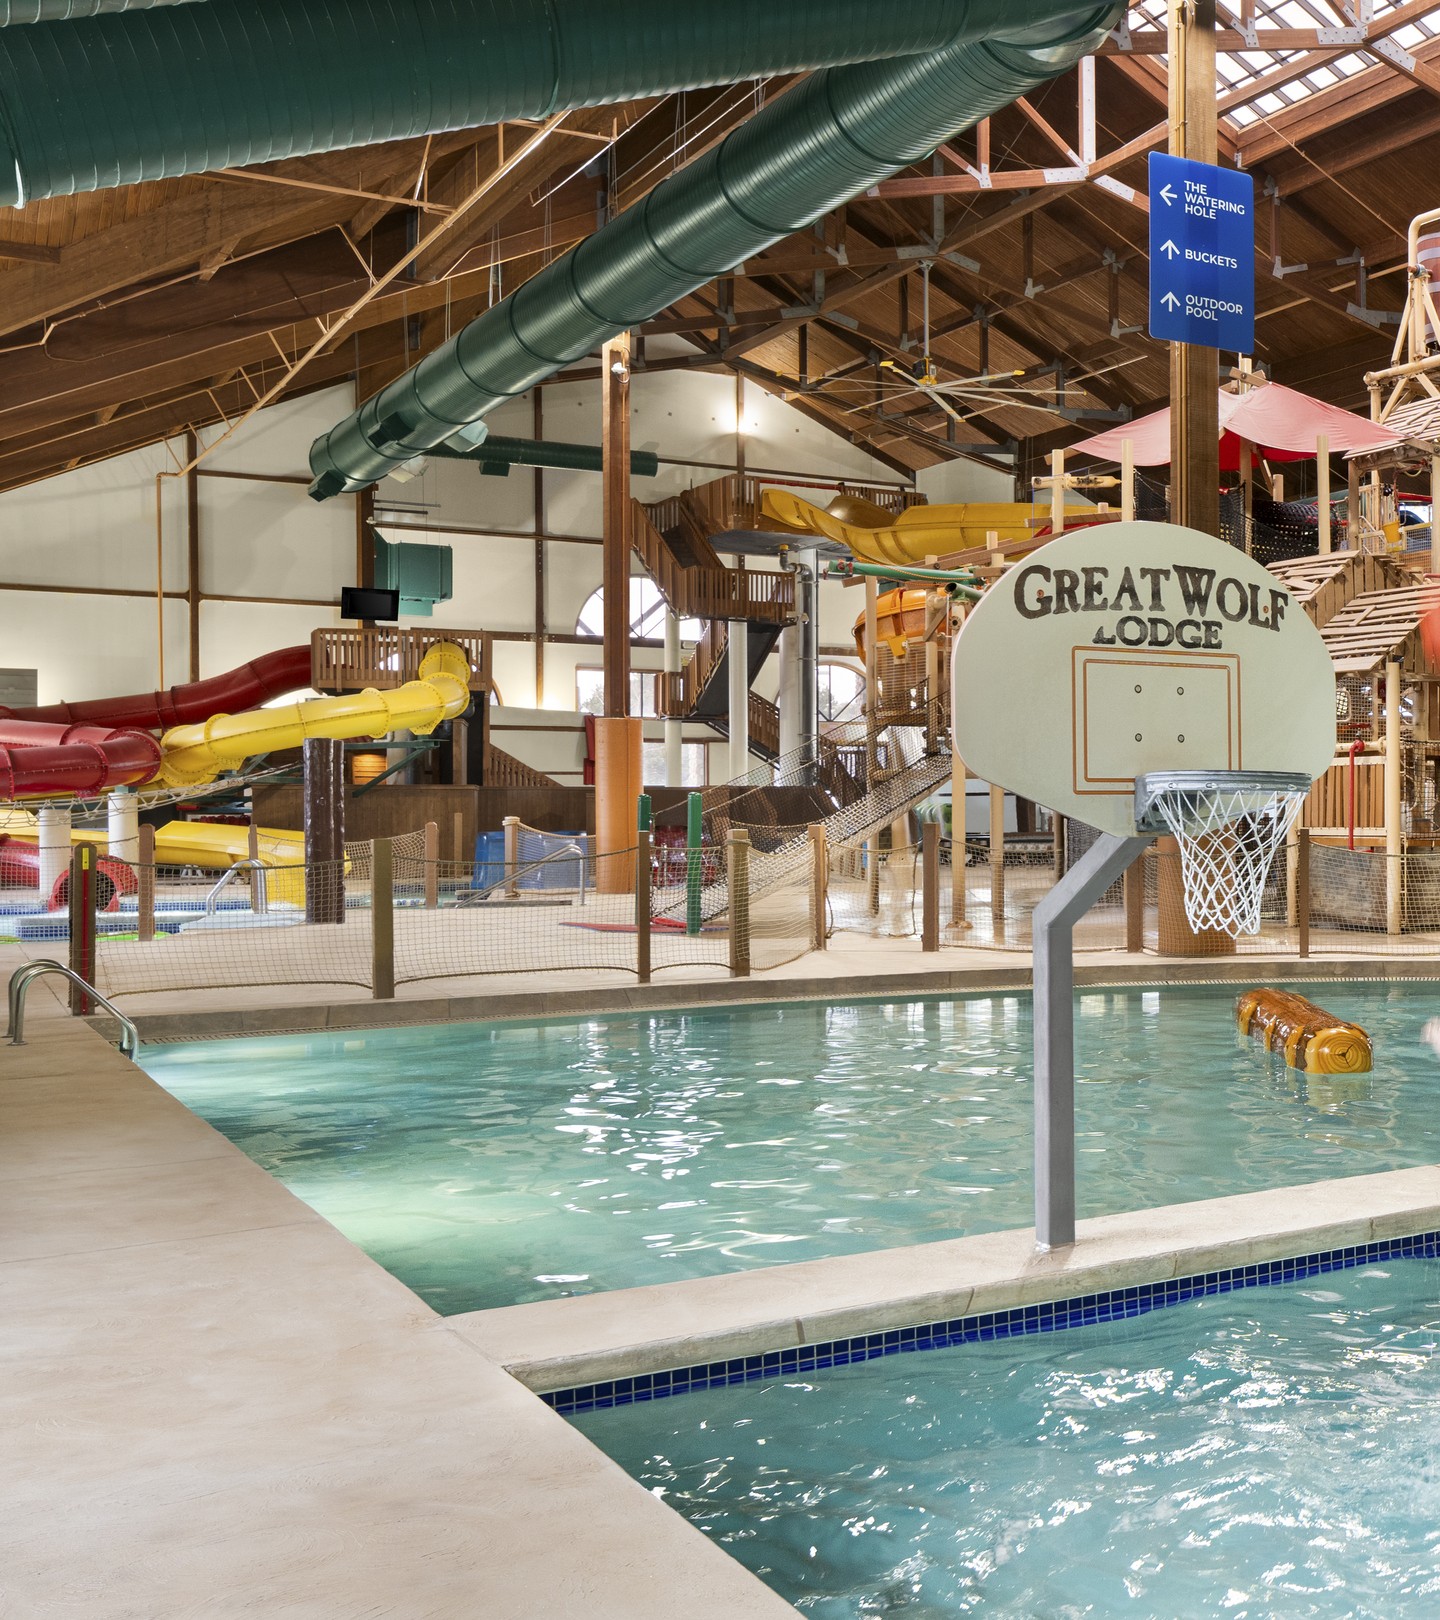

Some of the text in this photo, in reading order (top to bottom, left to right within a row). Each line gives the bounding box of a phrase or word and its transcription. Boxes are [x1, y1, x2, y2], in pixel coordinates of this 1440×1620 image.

[1184, 180, 1207, 195] THE
[1184, 192, 1245, 215] WATERING
[1184, 203, 1217, 220] HOLE
[1185, 248, 1238, 269] BUCKETS
[1185, 294, 1243, 315] OUTDOOR
[1185, 305, 1218, 321] POOL
[1013, 564, 1289, 632] GREAT WOLF
[1092, 616, 1223, 649] LODGE
